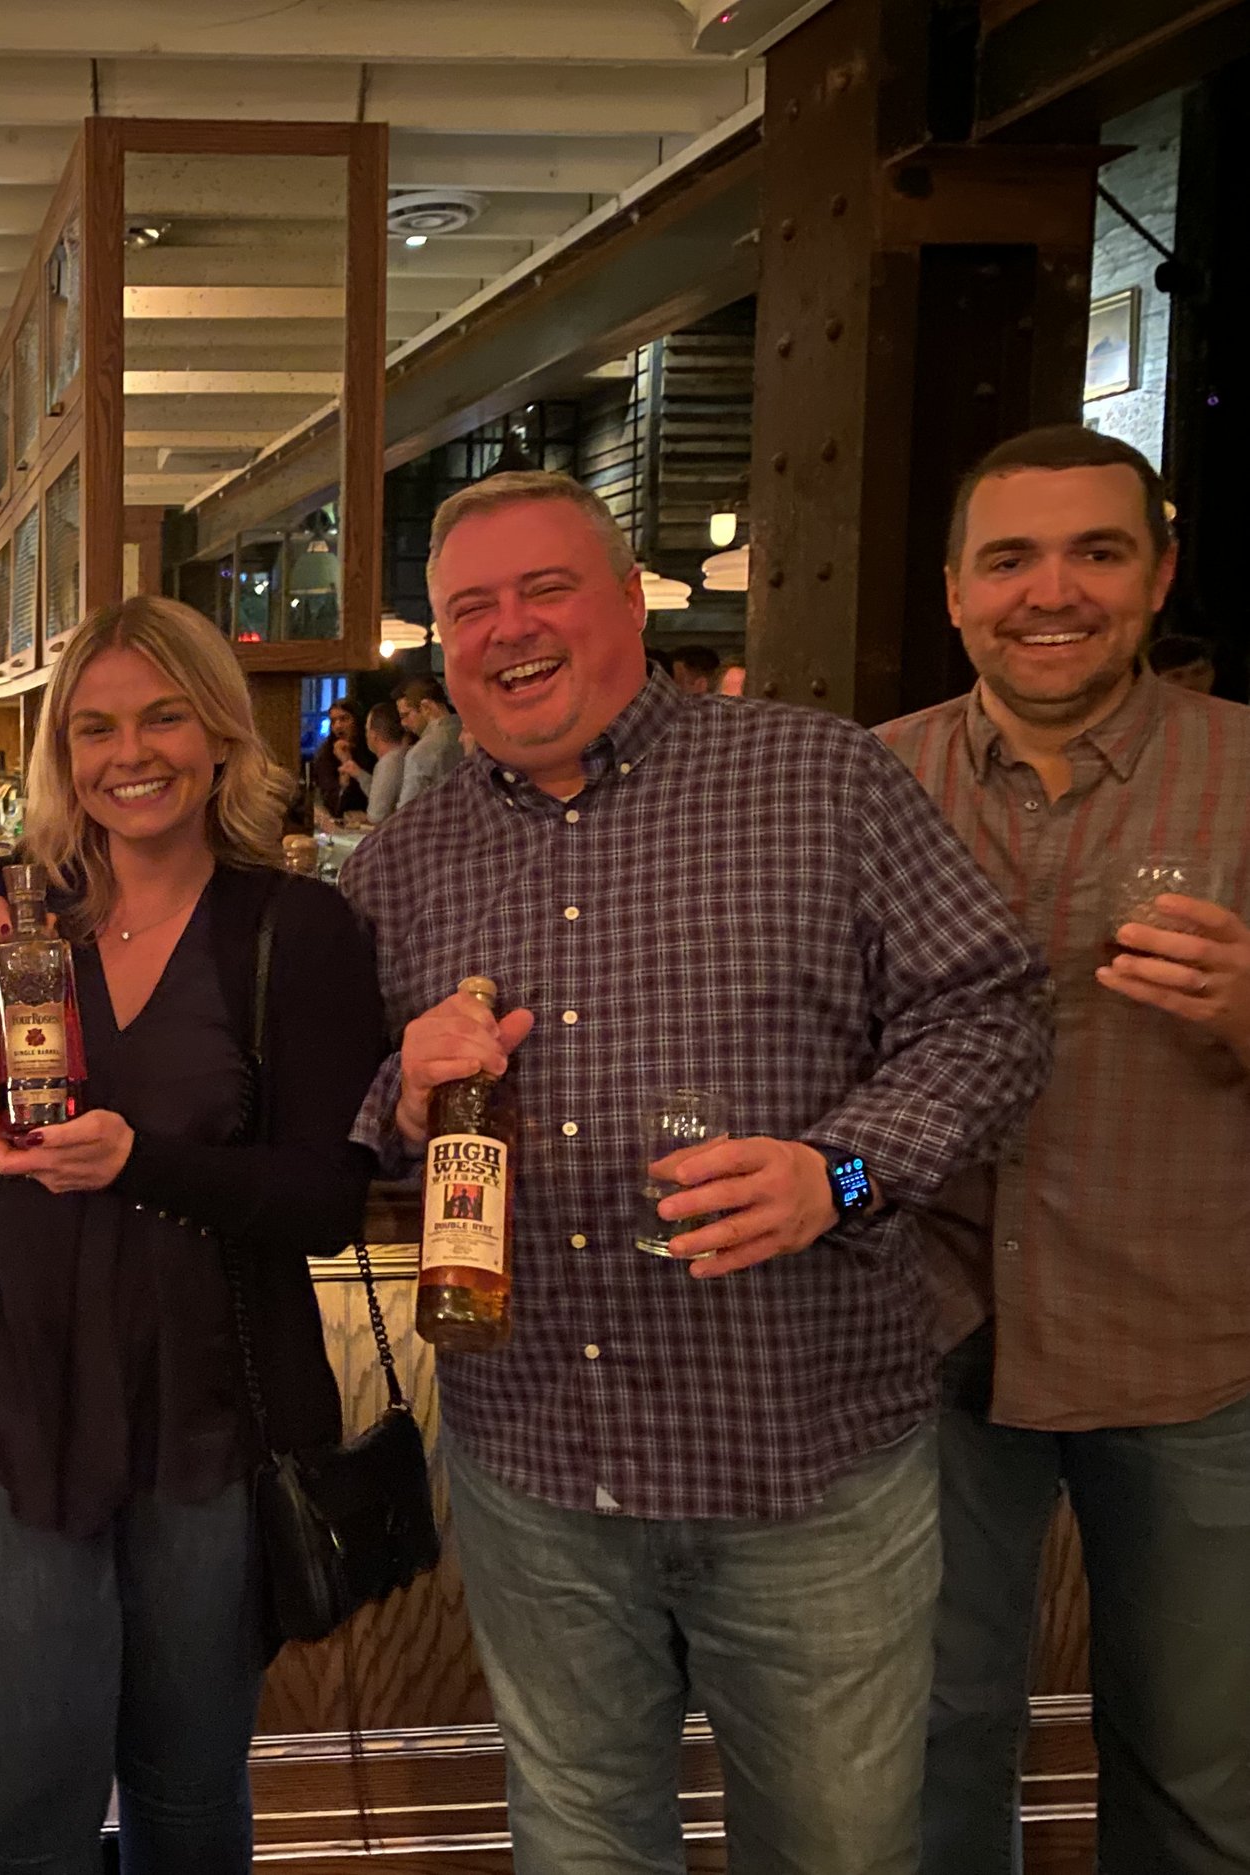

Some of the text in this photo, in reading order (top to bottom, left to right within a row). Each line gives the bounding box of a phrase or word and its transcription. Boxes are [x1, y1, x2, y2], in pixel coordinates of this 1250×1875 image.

[433, 1141, 501, 1166] HIGH
[433, 1160, 501, 1178] WEST
[431, 1173, 501, 1188] WHISKEY
